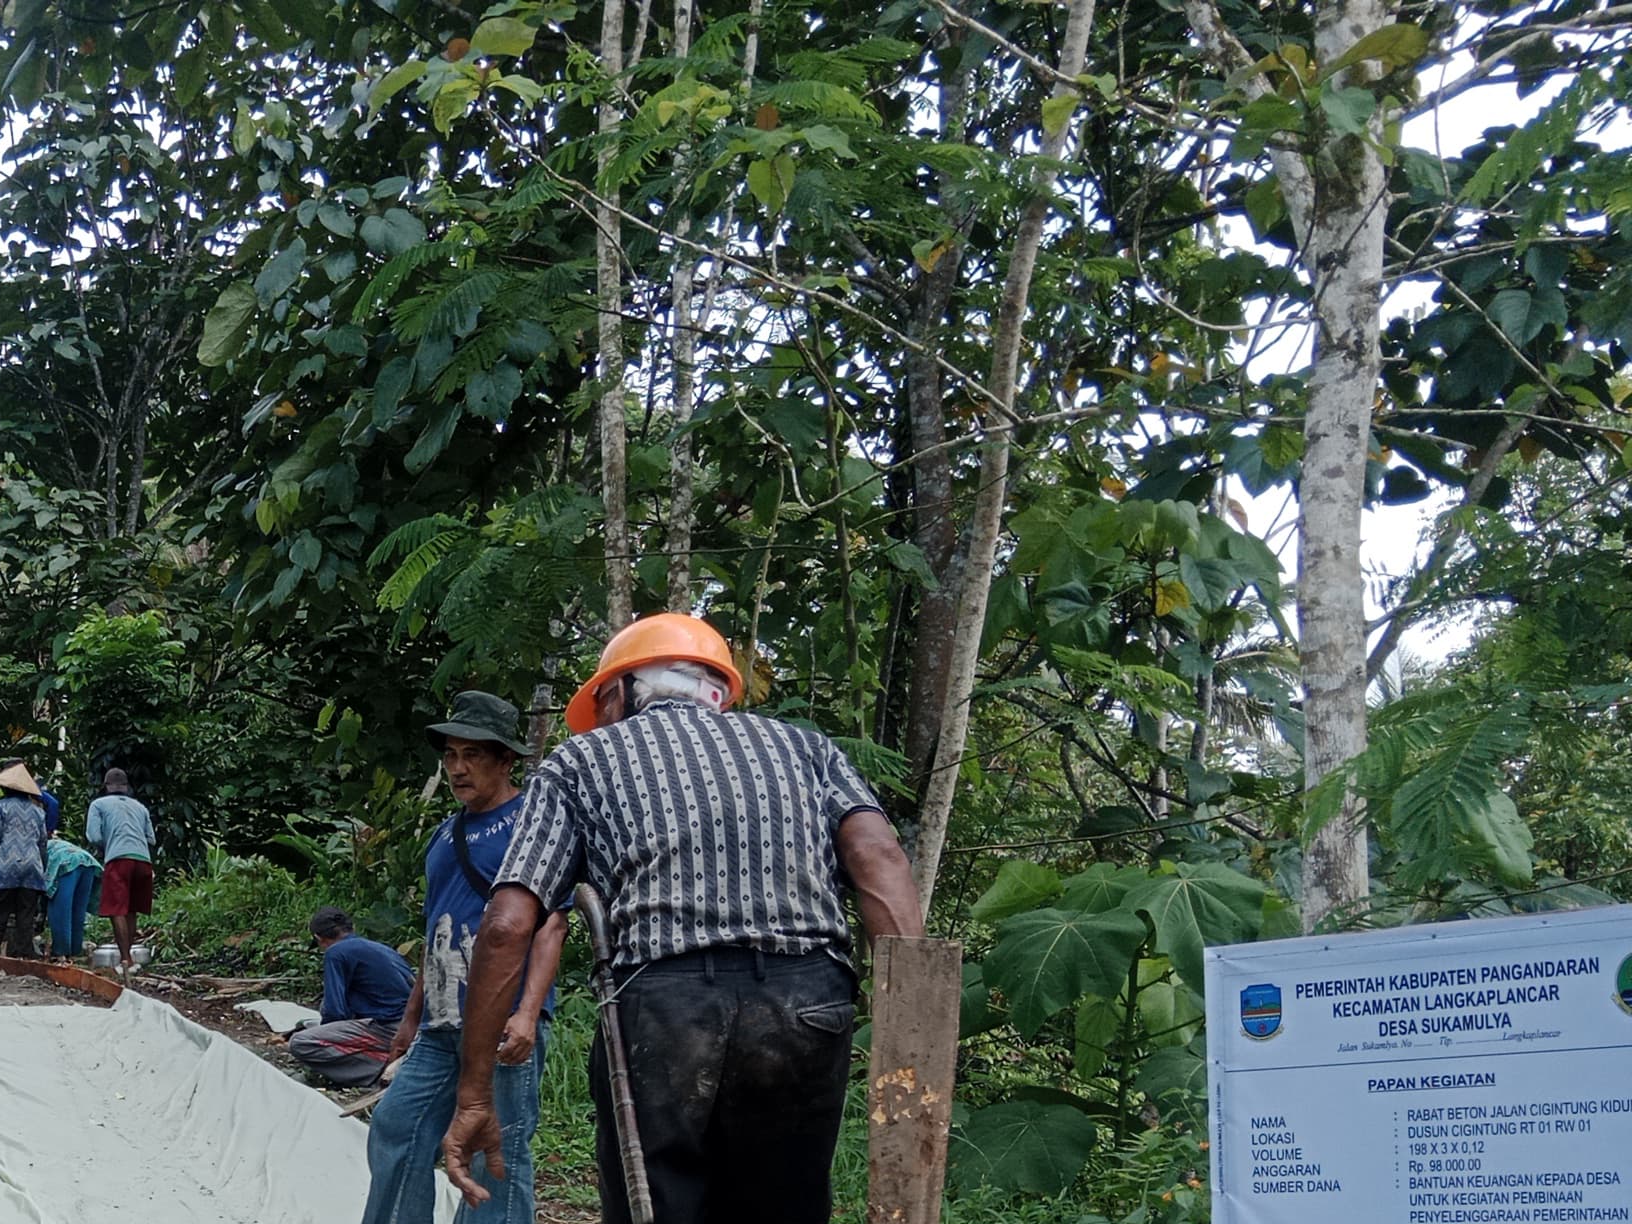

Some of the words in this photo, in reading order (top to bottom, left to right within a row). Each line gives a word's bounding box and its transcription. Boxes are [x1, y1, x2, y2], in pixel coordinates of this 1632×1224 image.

[1295, 976, 1385, 999] PEMERINTAH
[1389, 968, 1477, 991] KABUPATEN
[1481, 957, 1600, 983] PANGANDARAN
[1333, 996, 1420, 1018] KECAMATAN
[1424, 984, 1560, 1010] LANGKAPLANCAR
[1378, 1019, 1418, 1037] DESA
[1421, 1012, 1512, 1034] SUKAMULYA
[1367, 1077, 1417, 1092] PAPAN
[1420, 1072, 1495, 1089] KEGIATAN
[1251, 1116, 1287, 1129] NAMA
[1407, 1108, 1445, 1122] RABAT
[1447, 1106, 1487, 1120] BETON
[1490, 1104, 1527, 1118] JALAN
[1529, 1100, 1598, 1117] CIGINTUNG
[1600, 1099, 1632, 1113] KIDU
[1251, 1132, 1295, 1146] LOKASI
[1408, 1125, 1448, 1139] DUSUN
[1451, 1121, 1517, 1138] CIGINTUNG
[1520, 1121, 1536, 1135] RT
[1538, 1120, 1551, 1134] 01
[1555, 1119, 1576, 1133] RW
[1578, 1118, 1591, 1132] 01
[1252, 1147, 1303, 1161] VOLUME
[1409, 1142, 1428, 1156] 198
[1430, 1142, 1439, 1155] X
[1441, 1141, 1448, 1154] 3
[1450, 1141, 1459, 1154] X
[1461, 1140, 1485, 1155] 0,12
[1252, 1163, 1321, 1178] ANGGARAN
[1408, 1160, 1427, 1174] Rp.
[1253, 1180, 1304, 1194] SUMBER
[1307, 1179, 1342, 1193] DANA
[1409, 1176, 1464, 1190] BANTUAN
[1467, 1174, 1533, 1188] KEUANGAN
[1536, 1172, 1584, 1187] KEPADA
[1586, 1171, 1621, 1186] DESA
[1409, 1193, 1450, 1207] UNTUK
[1452, 1191, 1510, 1206] KEGIATAN
[1512, 1190, 1583, 1205] PEMBINAAN
[1410, 1209, 1530, 1224] PENYELENGGARAAN
[1533, 1207, 1629, 1222] PEMERINTAHAN
